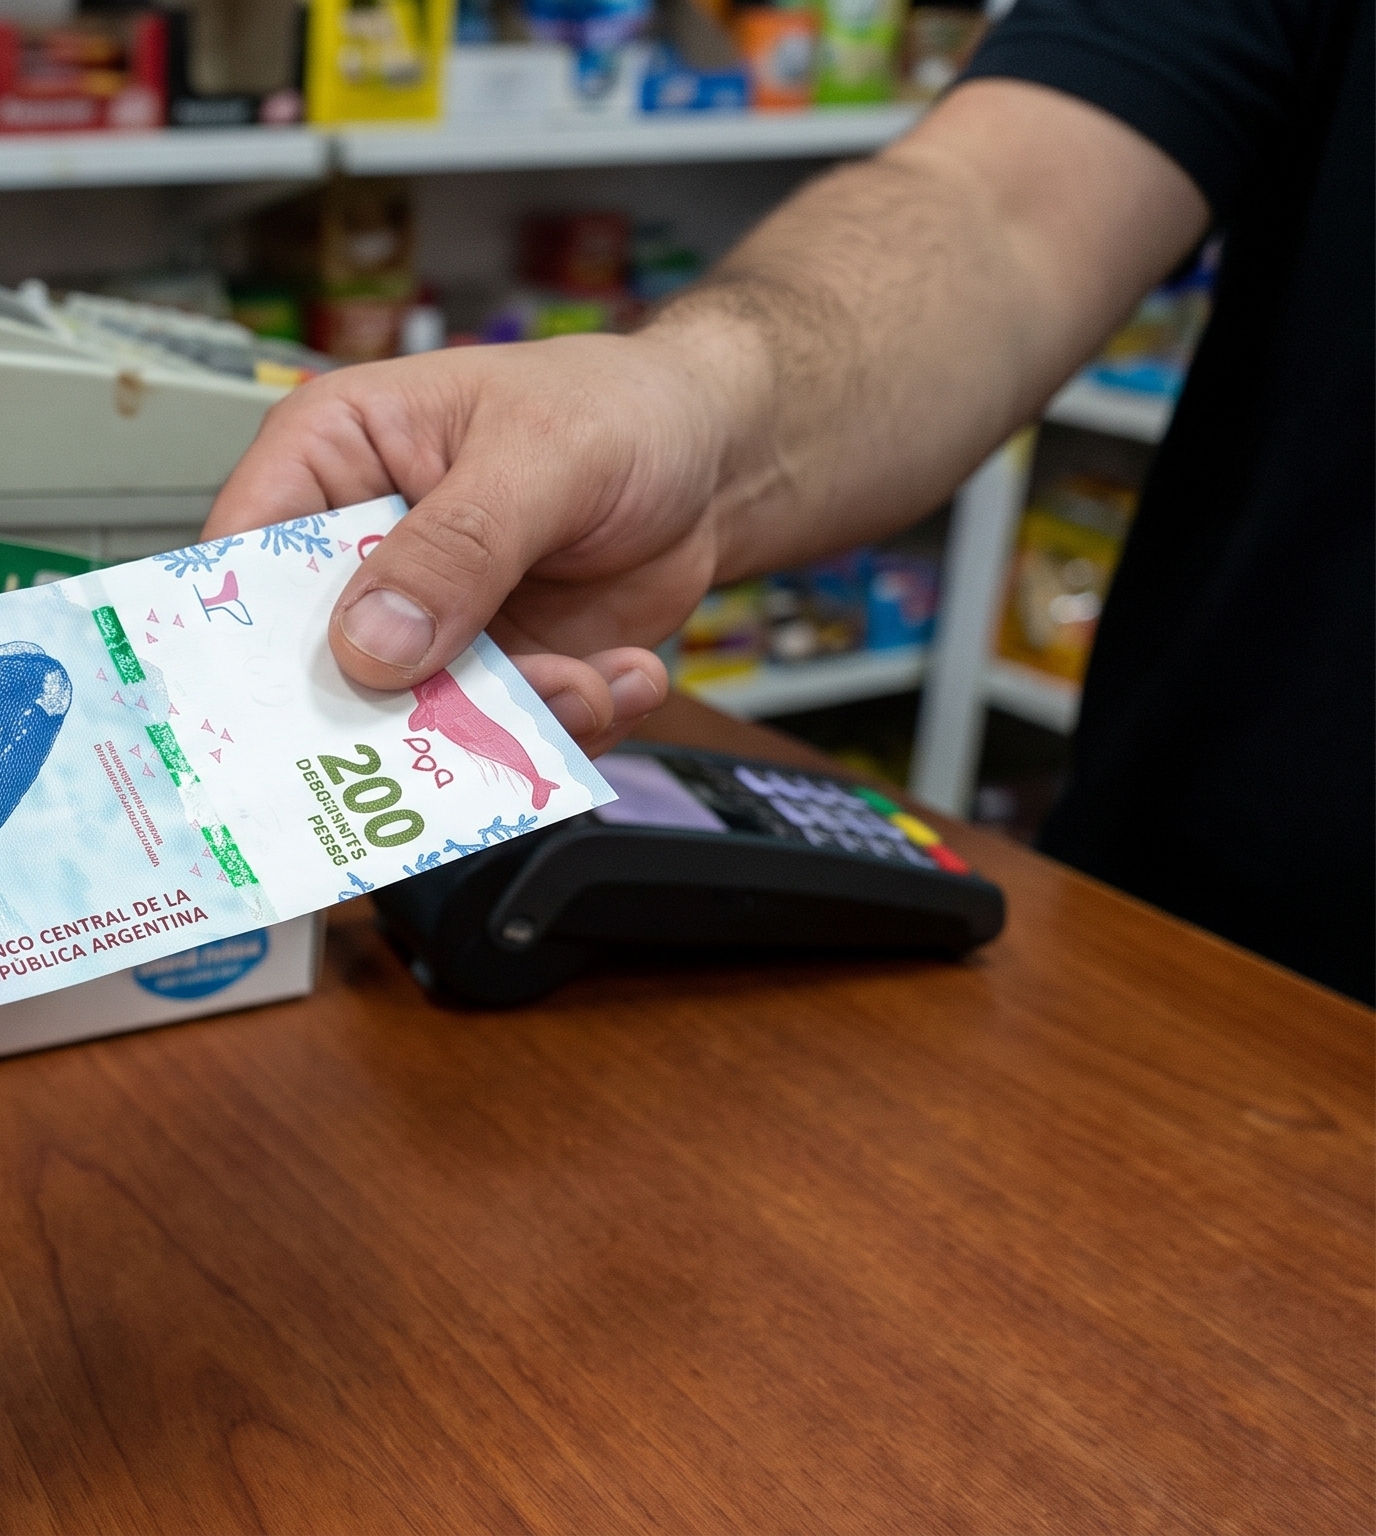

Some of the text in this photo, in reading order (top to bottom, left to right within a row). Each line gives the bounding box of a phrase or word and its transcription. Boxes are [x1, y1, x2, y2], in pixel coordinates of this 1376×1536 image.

[316, 743, 426, 848] 200
[39, 907, 131, 944] CENTRAL
[132, 896, 162, 918] DE
[163, 888, 192, 909] LA
[91, 906, 209, 954] ARGENTINA
